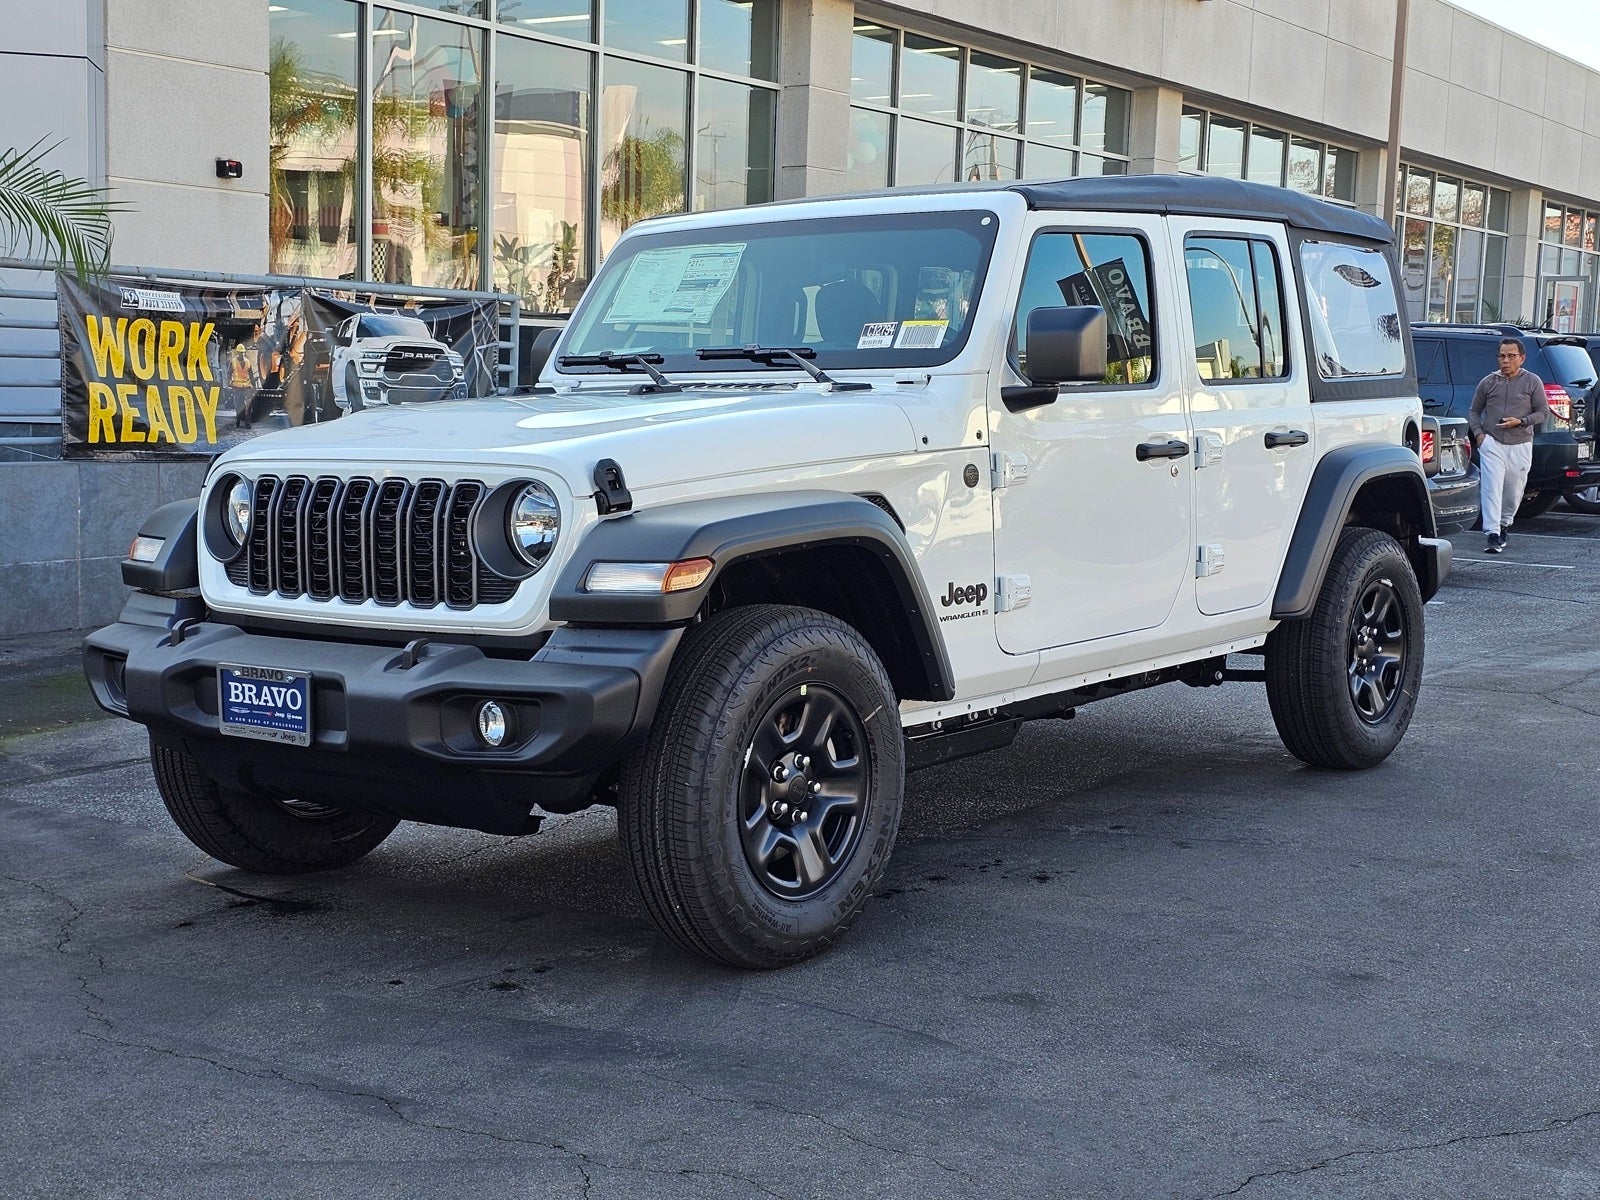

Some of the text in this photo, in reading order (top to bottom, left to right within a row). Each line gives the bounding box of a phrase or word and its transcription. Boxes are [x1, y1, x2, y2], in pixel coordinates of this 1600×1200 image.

[86, 314, 215, 382] WORK
[88, 382, 221, 445] READY
[941, 582, 988, 607] Jeep
[939, 610, 981, 622] WRANGLER
[241, 667, 284, 680] BRAVO
[228, 681, 302, 711] BRAVO
[281, 731, 297, 743] Jeep
[838, 814, 892, 914] NEXEN
